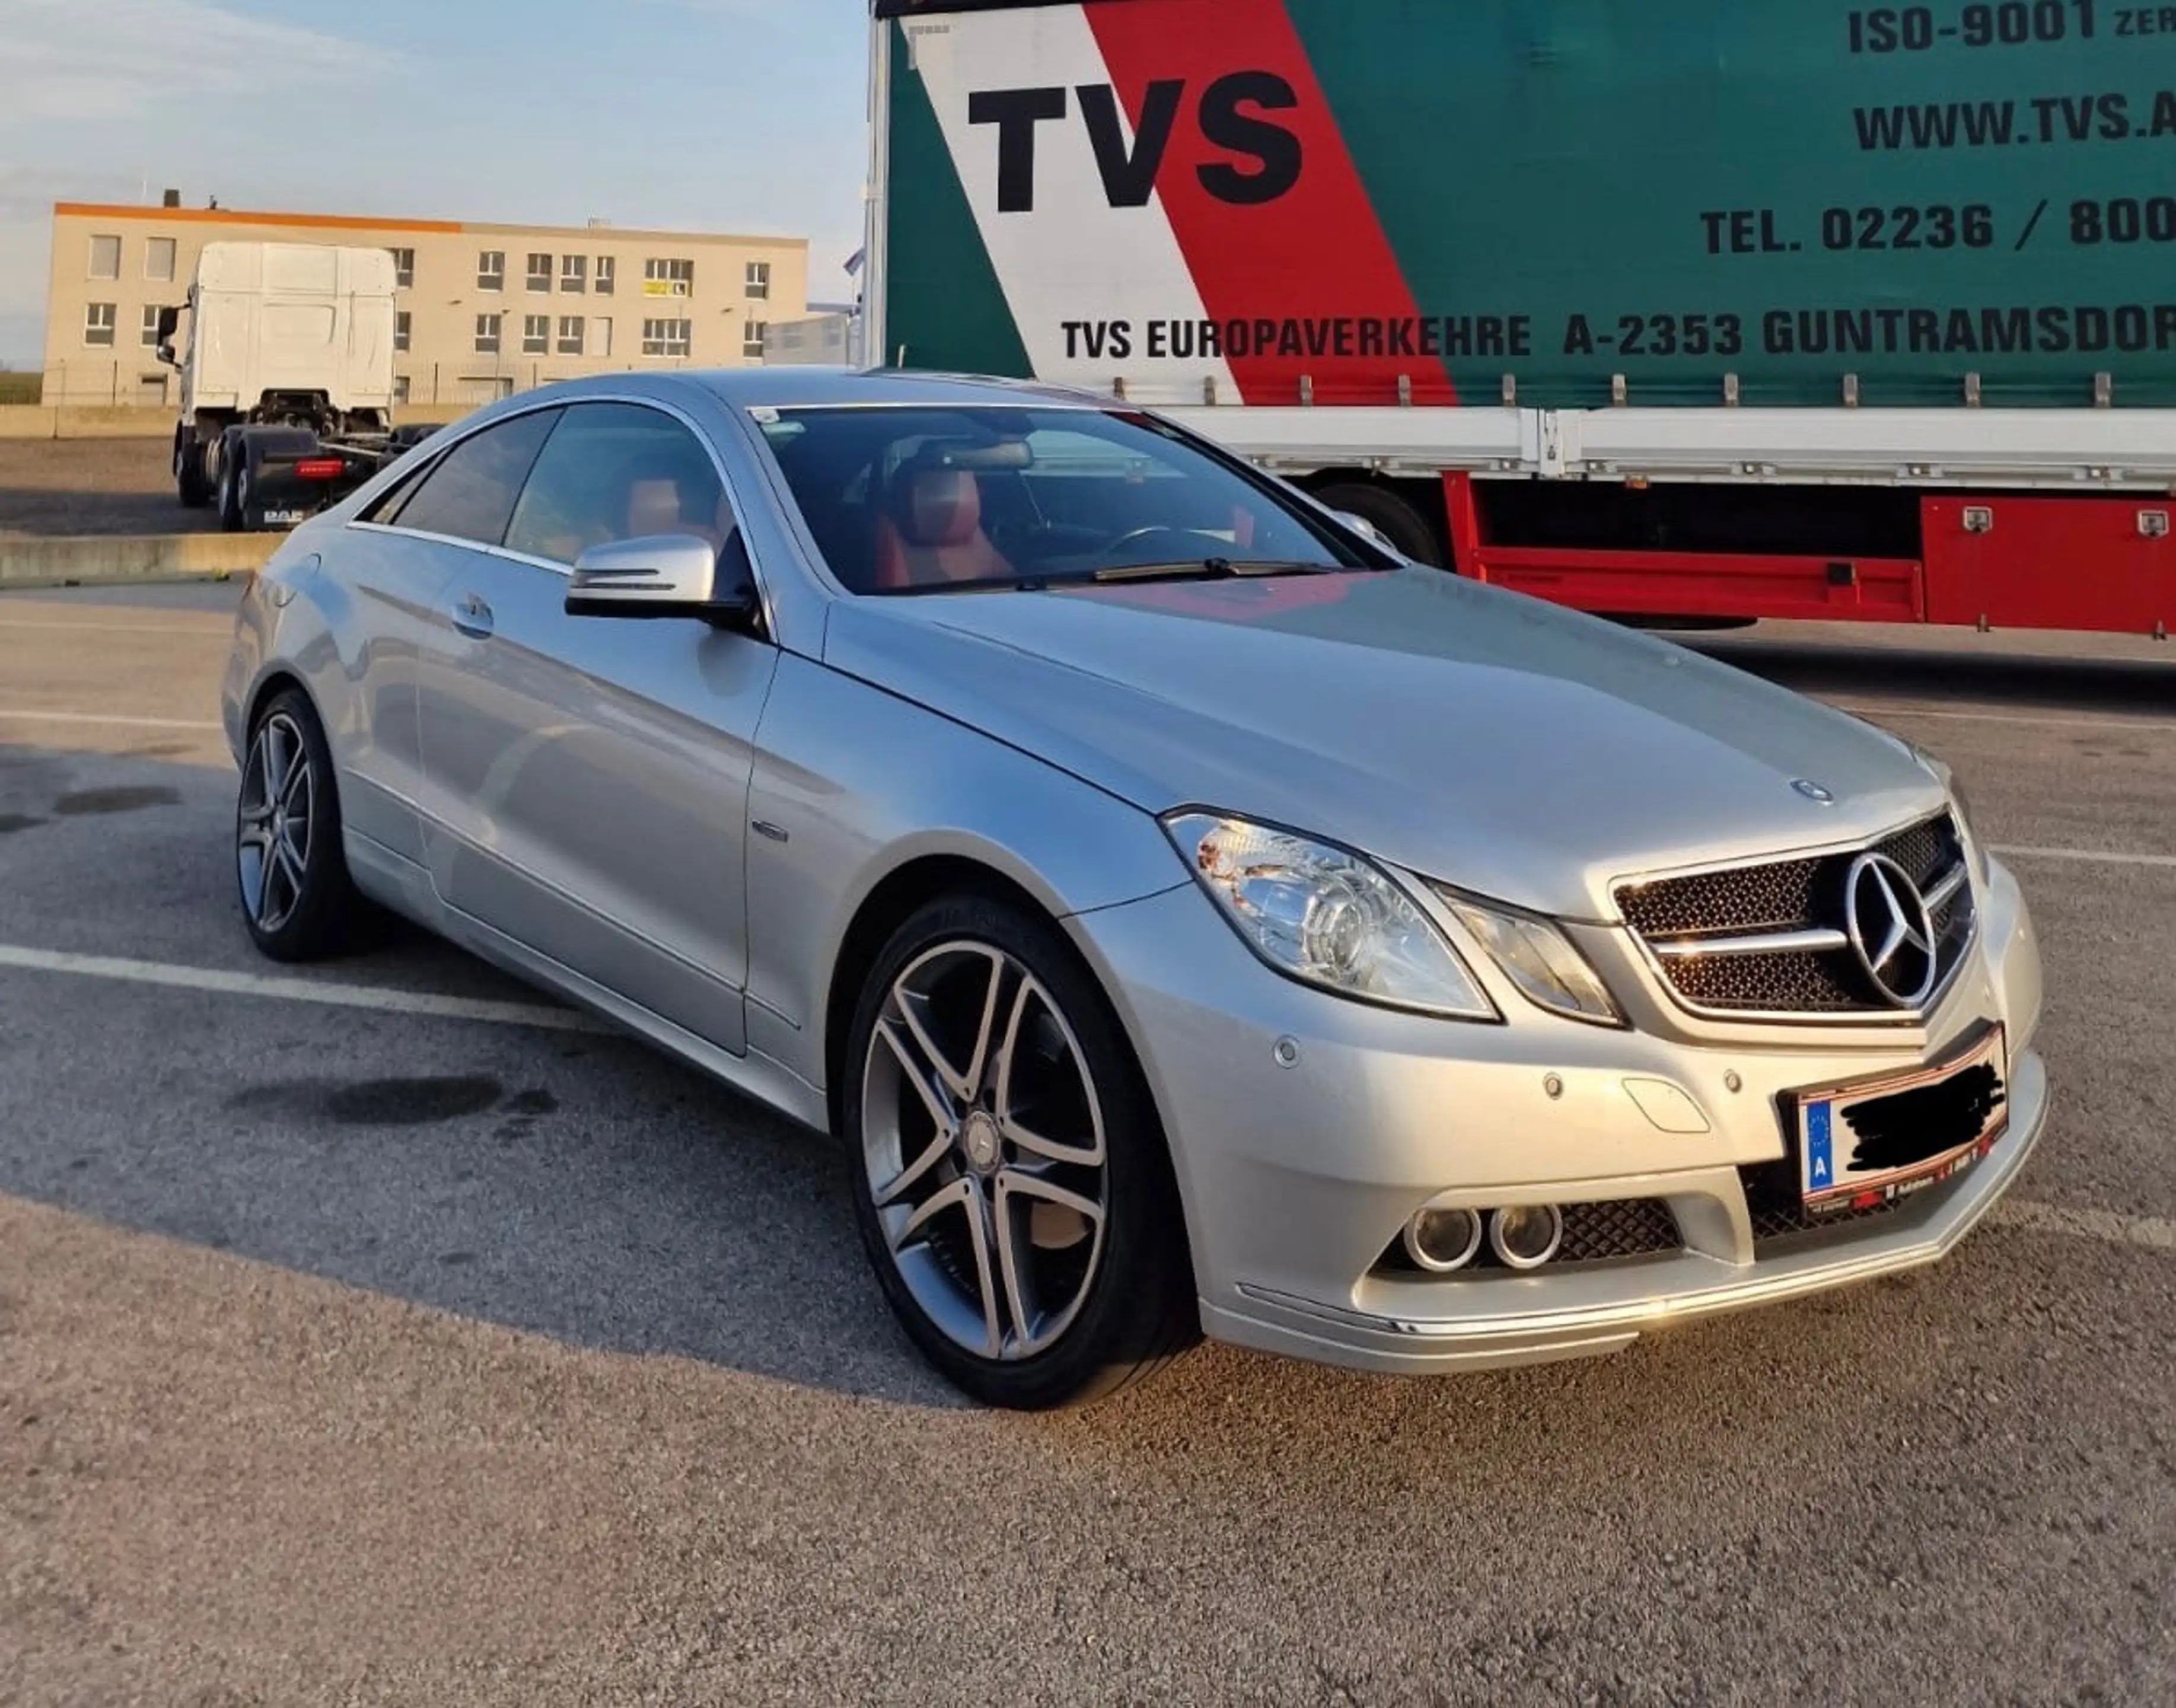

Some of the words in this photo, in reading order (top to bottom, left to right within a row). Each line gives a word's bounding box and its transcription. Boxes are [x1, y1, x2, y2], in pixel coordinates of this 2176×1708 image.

[1849, 0, 2094, 52] ISO-9001
[969, 71, 1302, 212] TVS
[1700, 210, 1801, 254] TEL.
[1823, 205, 1993, 250] 02236
[2015, 199, 2048, 251] /
[1062, 320, 1132, 358] TVS
[1148, 315, 1531, 357] EUROPAVERKEHRE
[1563, 313, 1741, 356] A-2353
[1815, 1156, 1827, 1177] A
